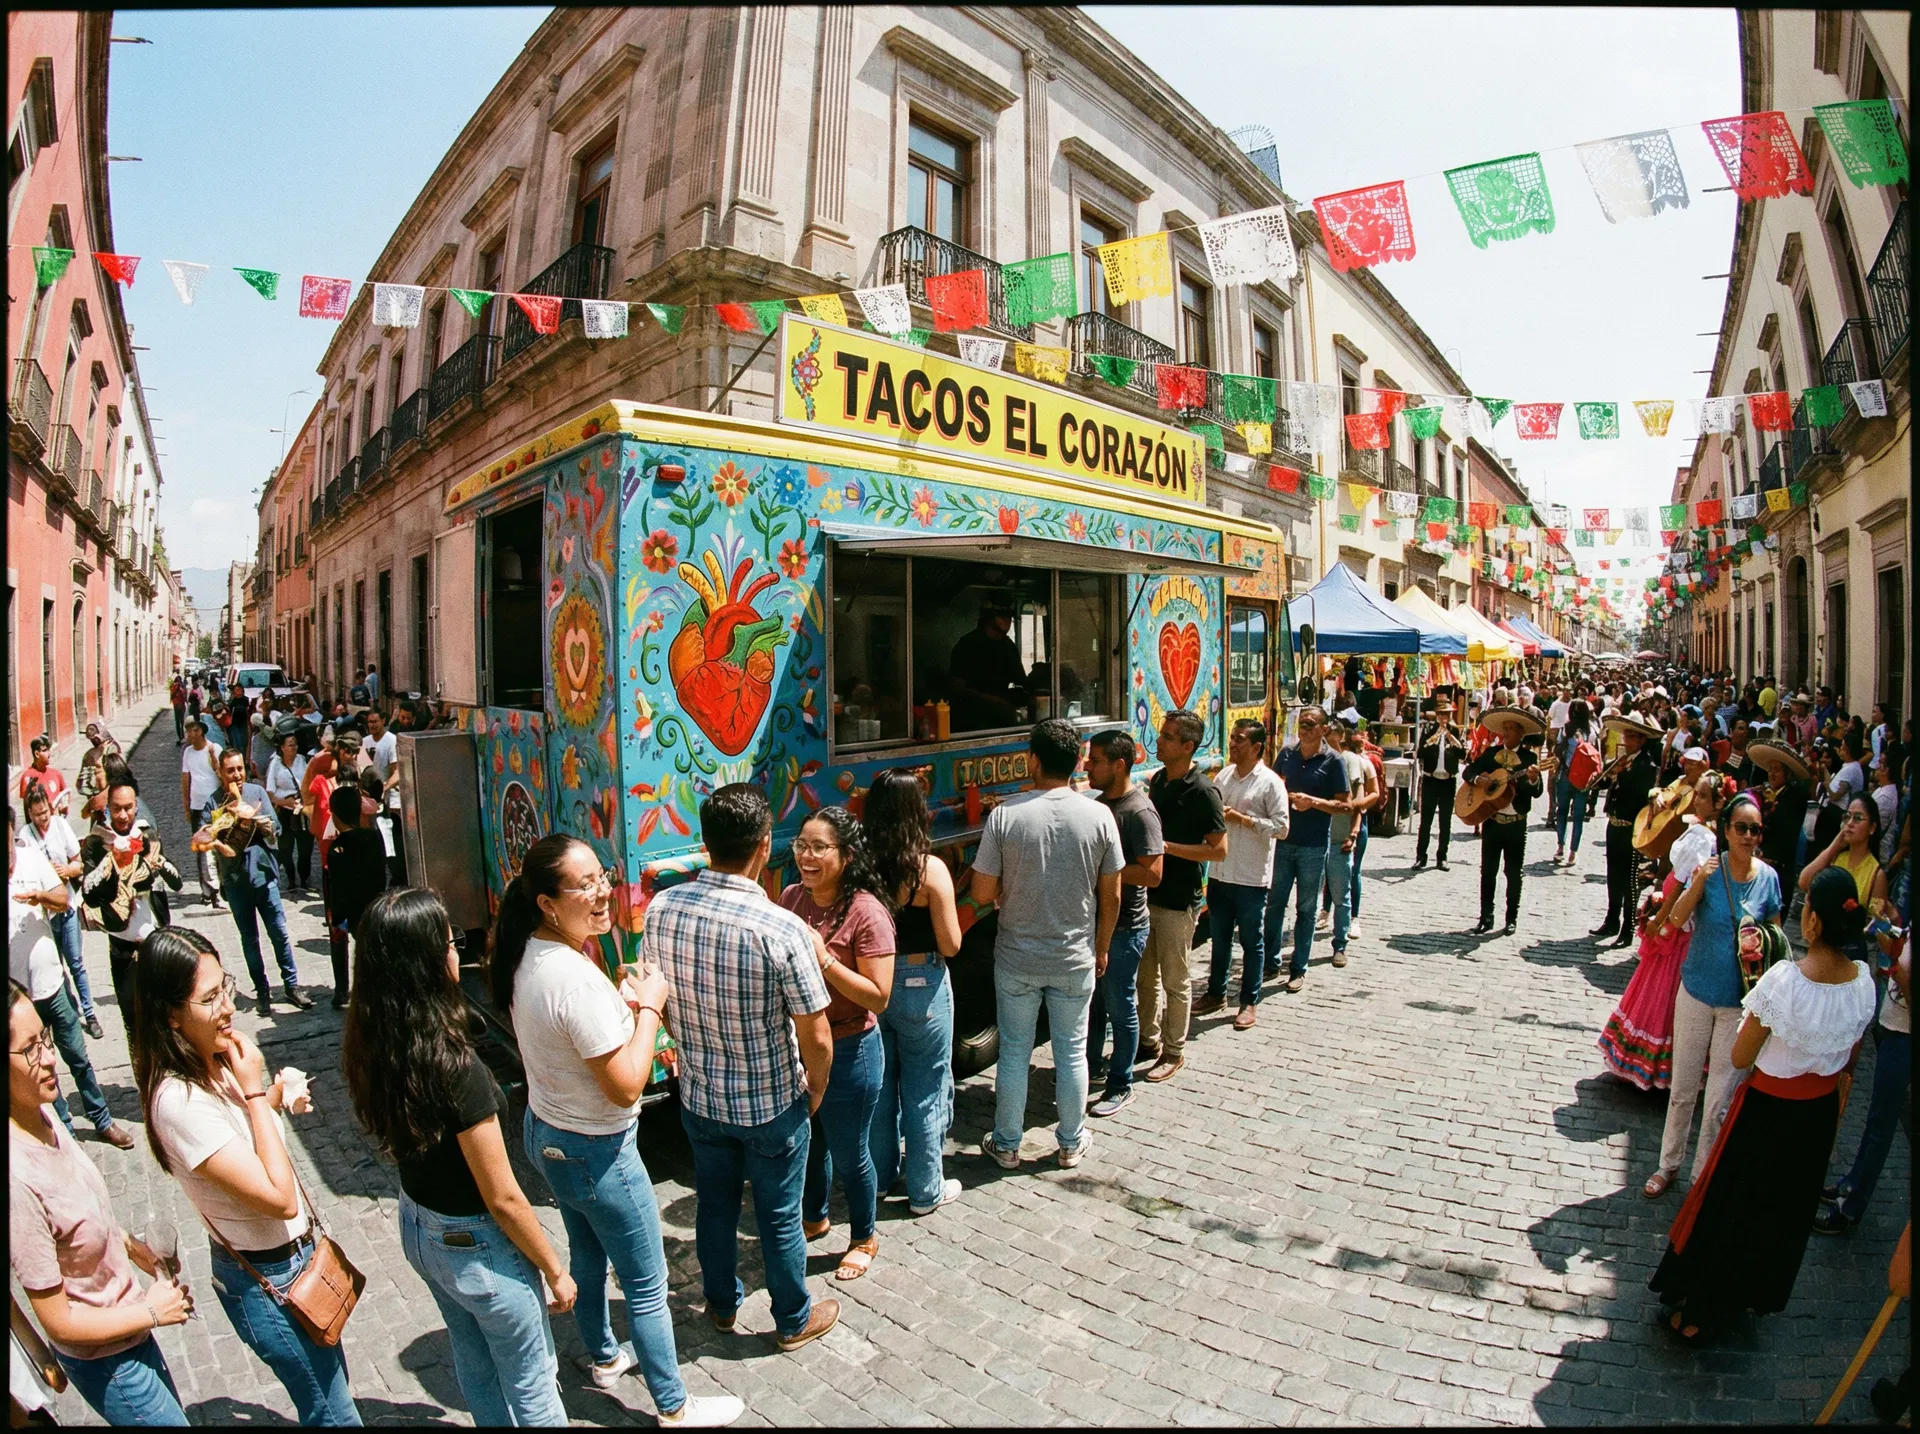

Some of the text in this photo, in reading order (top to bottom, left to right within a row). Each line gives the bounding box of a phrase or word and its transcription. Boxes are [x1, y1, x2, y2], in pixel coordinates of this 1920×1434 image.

[834, 351, 1187, 493] TACOS EL CORAZÓN
